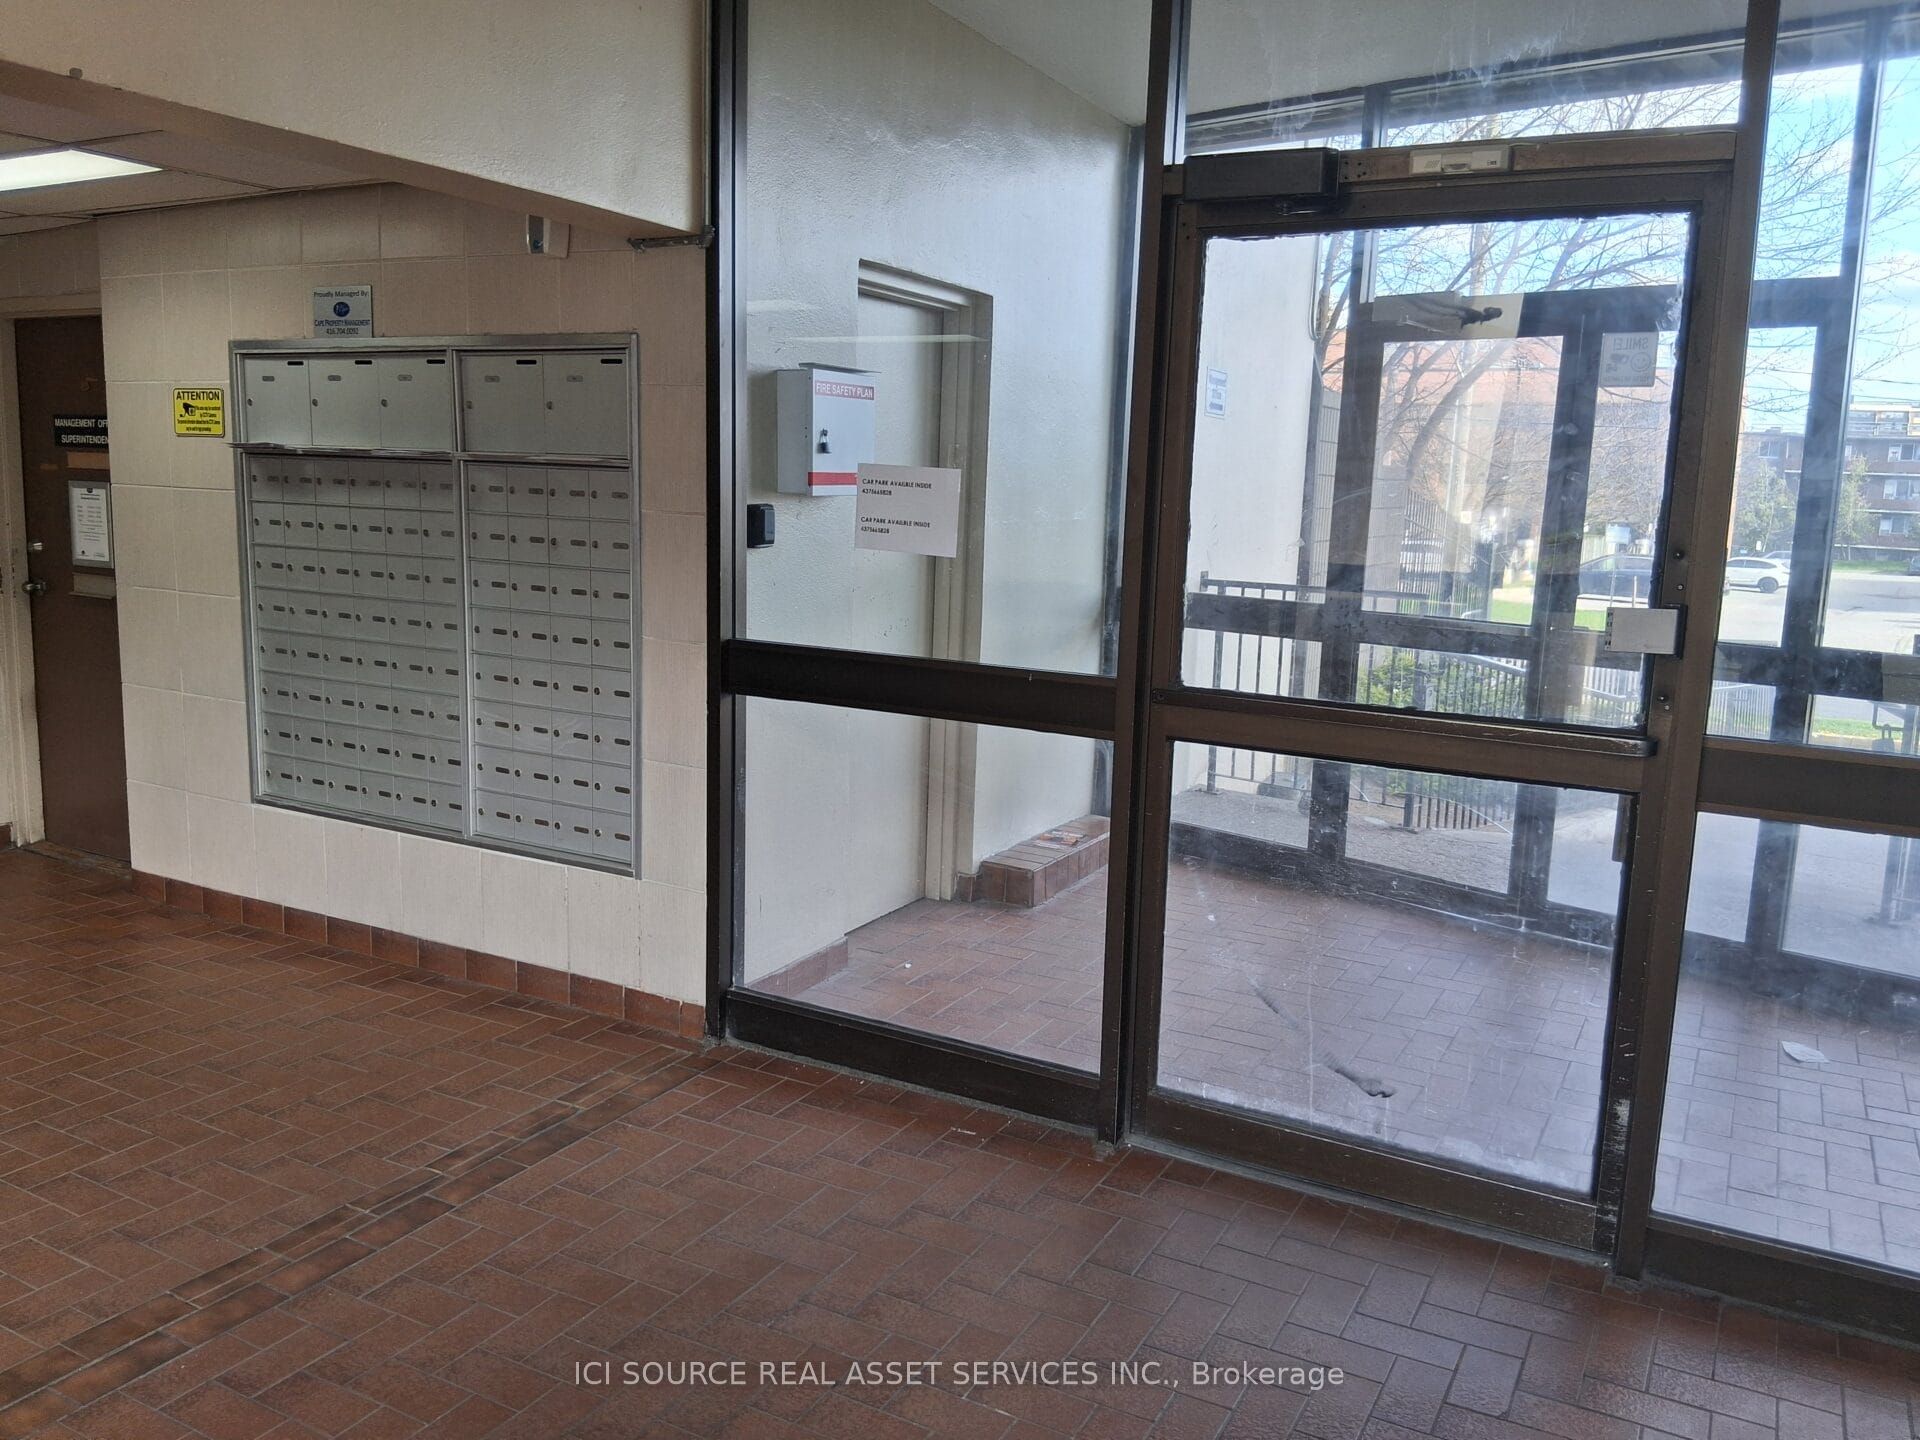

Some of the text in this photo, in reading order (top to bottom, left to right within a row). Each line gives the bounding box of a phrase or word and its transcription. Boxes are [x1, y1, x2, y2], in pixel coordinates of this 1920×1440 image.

[335, 290, 359, 298] Managed
[324, 319, 343, 327] PROPERTY
[176, 390, 220, 401] ATTENTION
[816, 383, 874, 399] FIRE SAFETY PLAN
[54, 418, 95, 428] MANAGEMENT
[862, 478, 874, 486] CAR
[914, 482, 932, 490] INSIDE
[861, 516, 873, 524] CAR
[913, 521, 931, 529] INSIDE
